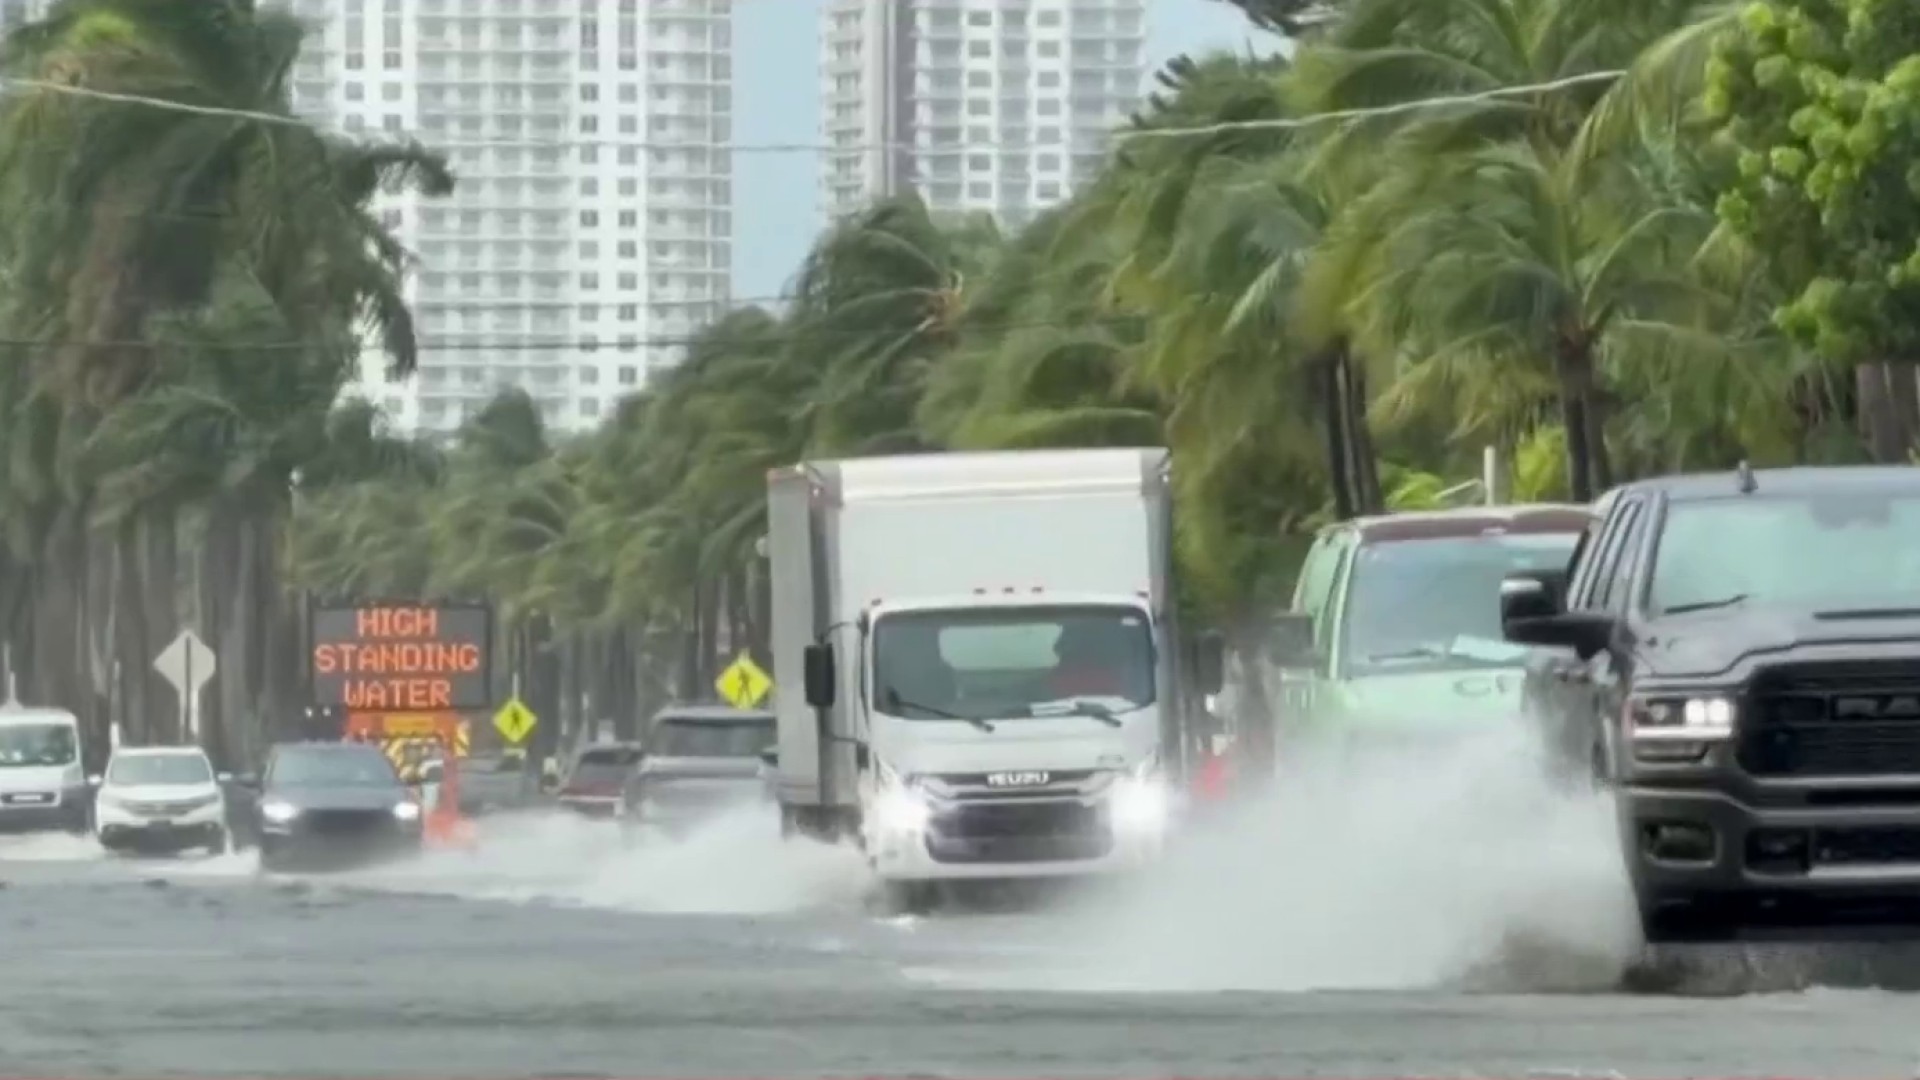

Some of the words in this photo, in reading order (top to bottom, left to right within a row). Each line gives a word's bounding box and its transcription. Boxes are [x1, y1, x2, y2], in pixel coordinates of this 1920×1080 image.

[359, 606, 437, 636] HIGH
[315, 643, 479, 673] STANDING
[344, 678, 450, 708] WATER
